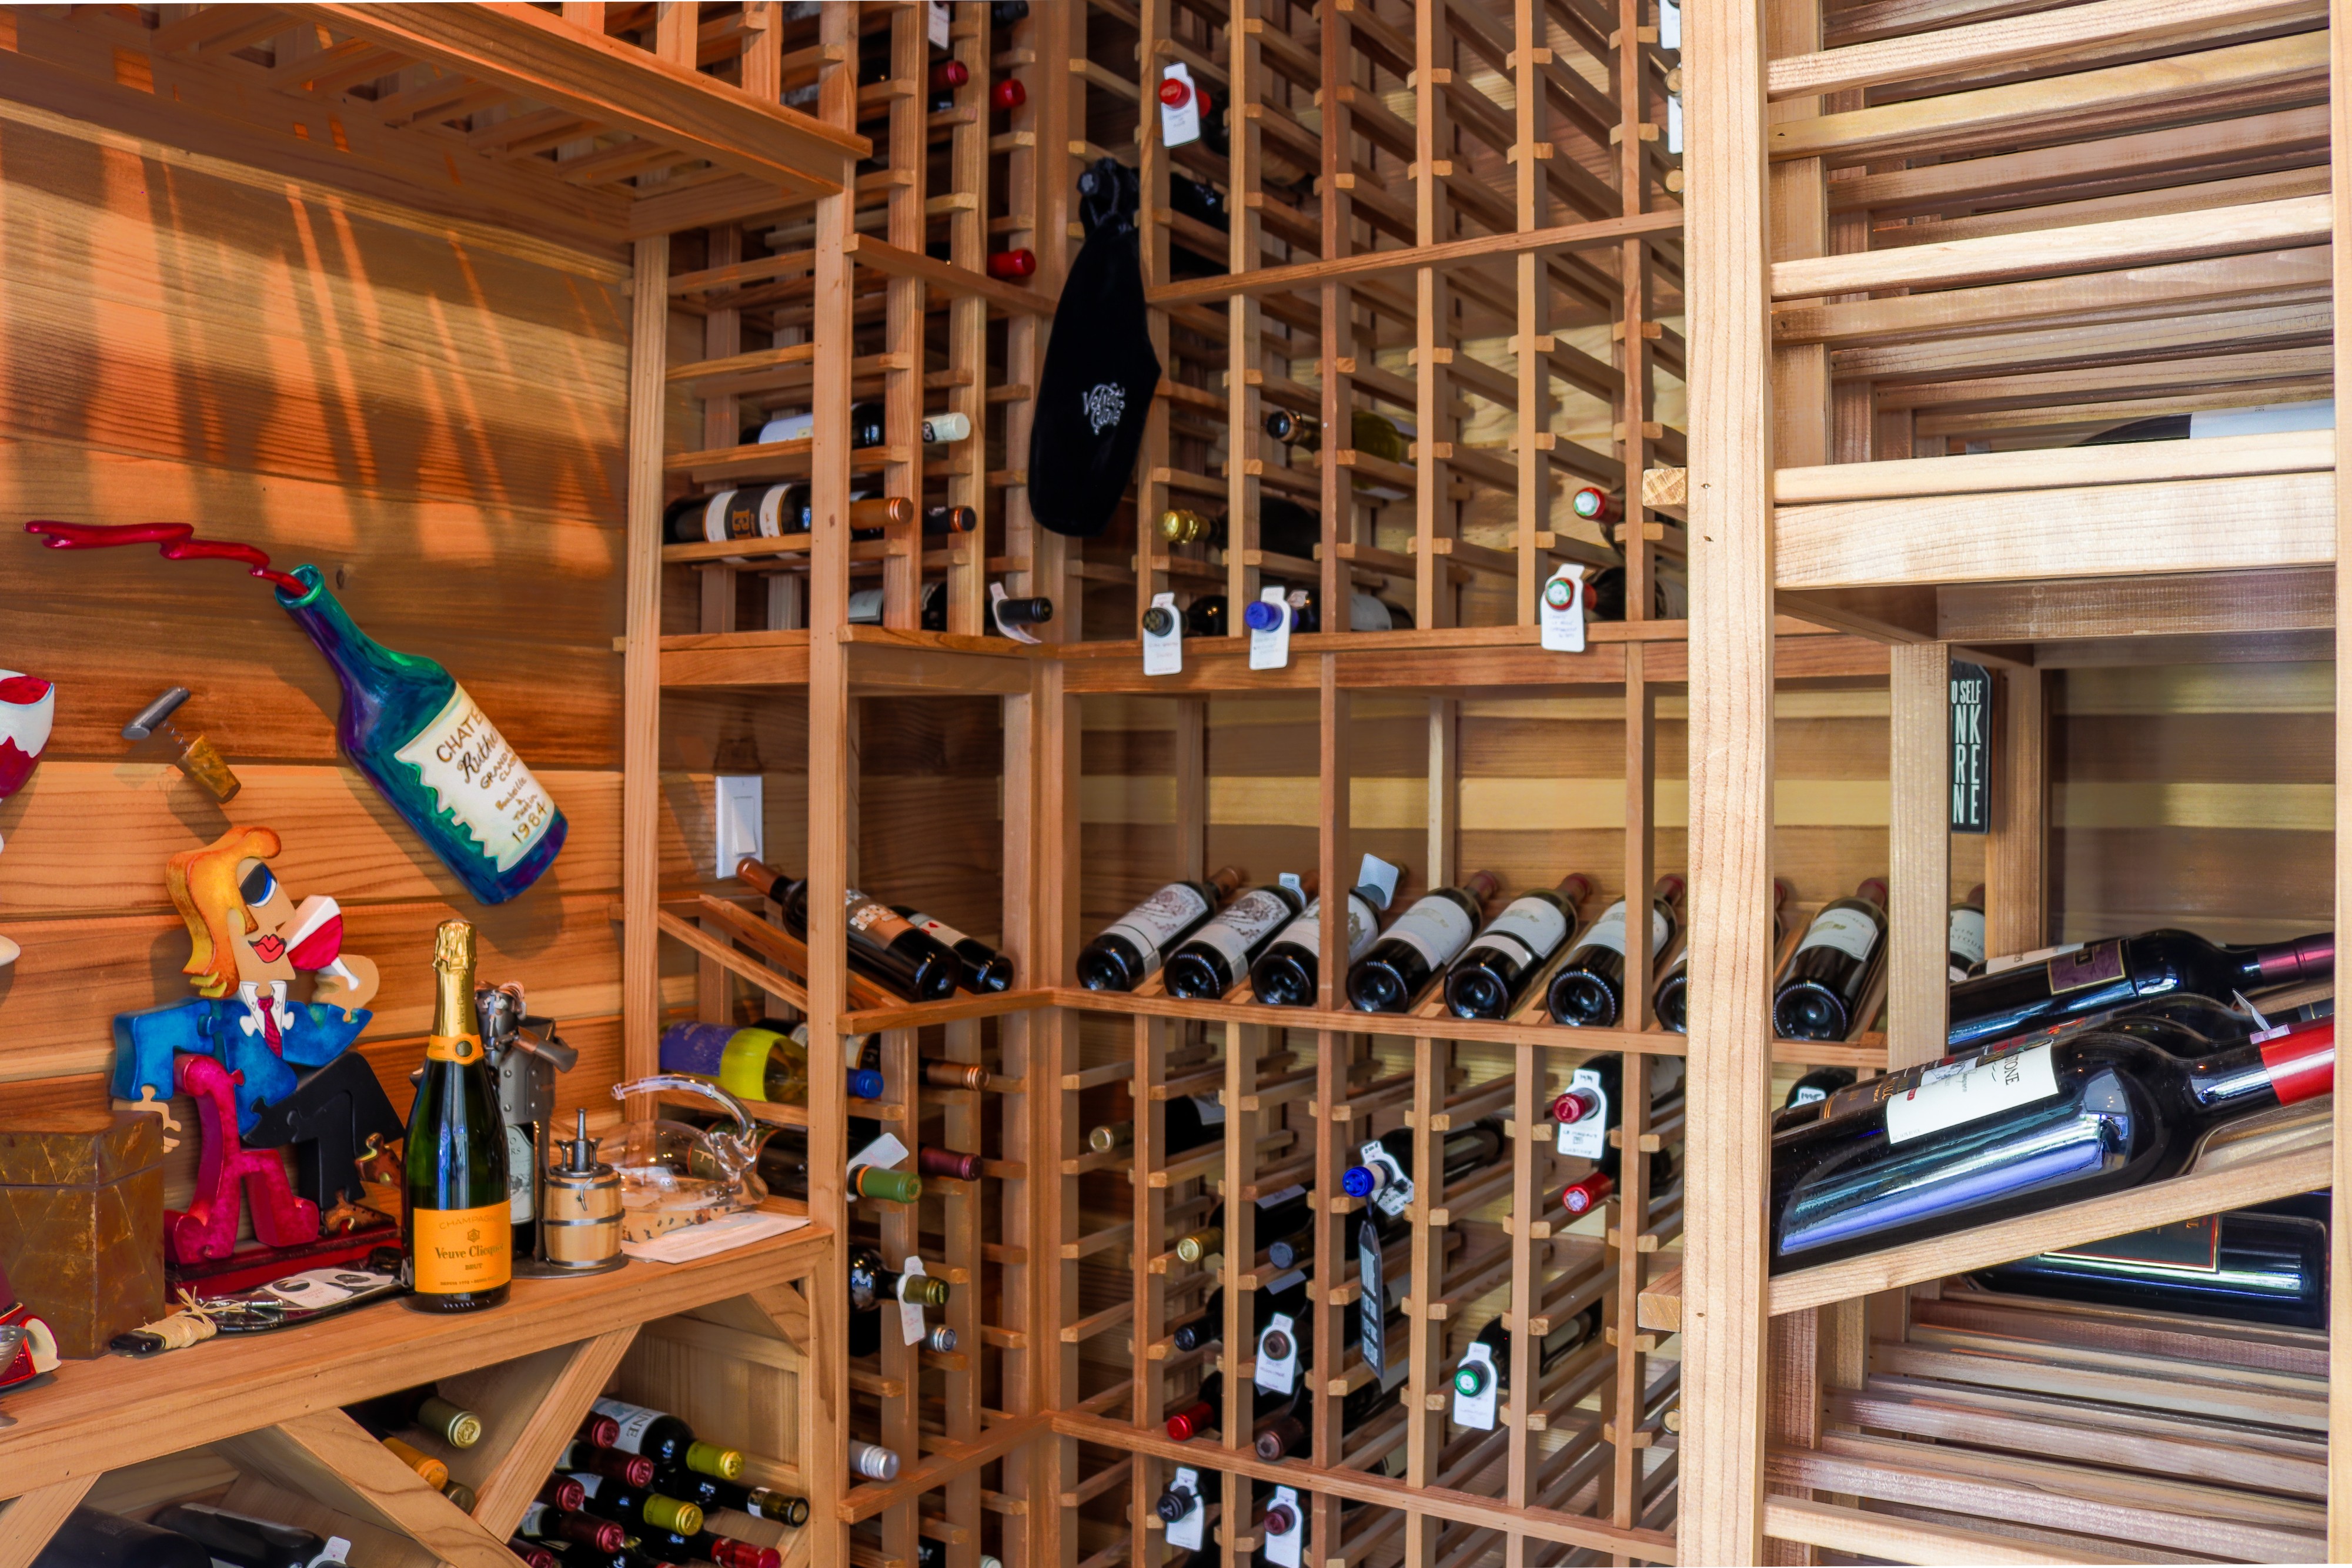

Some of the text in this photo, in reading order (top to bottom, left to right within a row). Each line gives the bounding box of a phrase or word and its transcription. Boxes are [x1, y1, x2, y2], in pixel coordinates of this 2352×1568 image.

[1951, 680, 1982, 704] O SELF
[511, 800, 547, 845] 1984
[510, 1146, 522, 1155] RS
[435, 1242, 504, 1259] Veuve Clicquot
